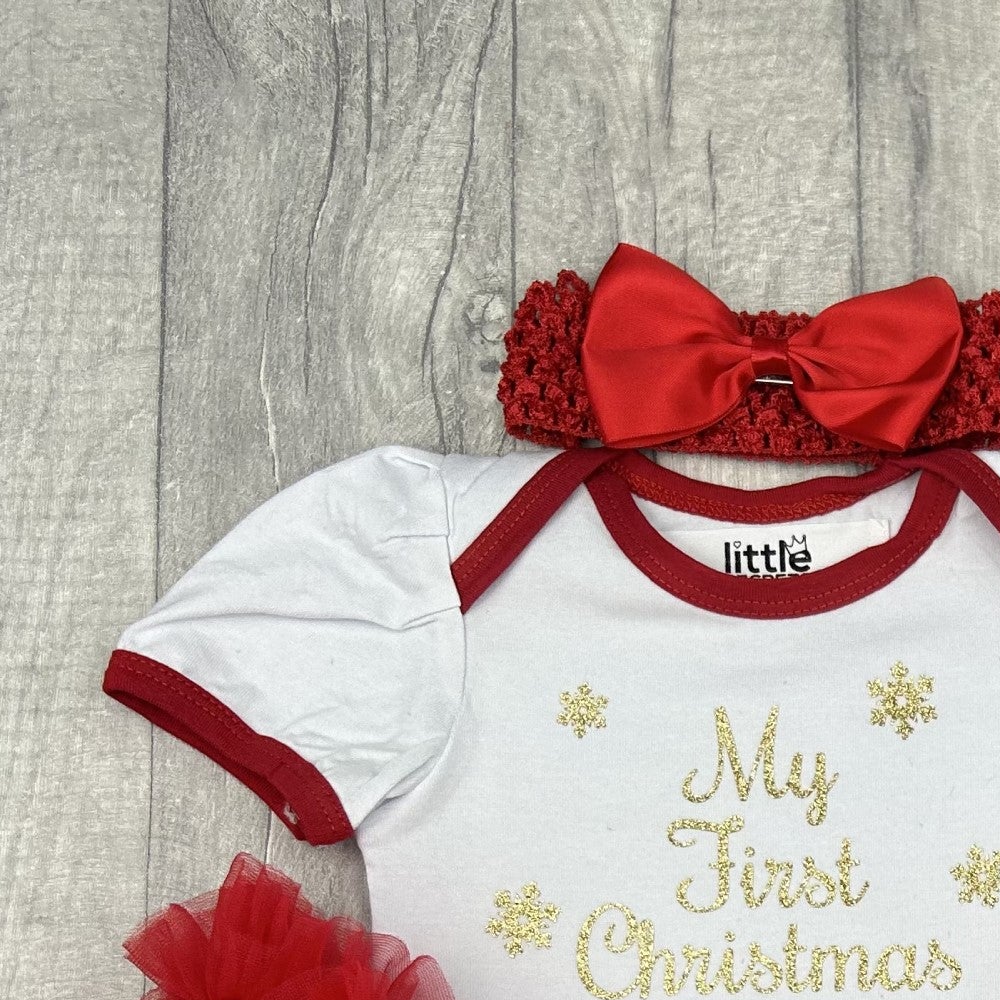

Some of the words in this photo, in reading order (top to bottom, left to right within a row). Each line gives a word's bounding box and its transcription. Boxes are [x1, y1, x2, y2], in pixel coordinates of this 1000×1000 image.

[724, 539, 812, 573] little
[682, 705, 839, 826] My
[667, 815, 870, 913] First
[576, 902, 962, 1000] Christmas
